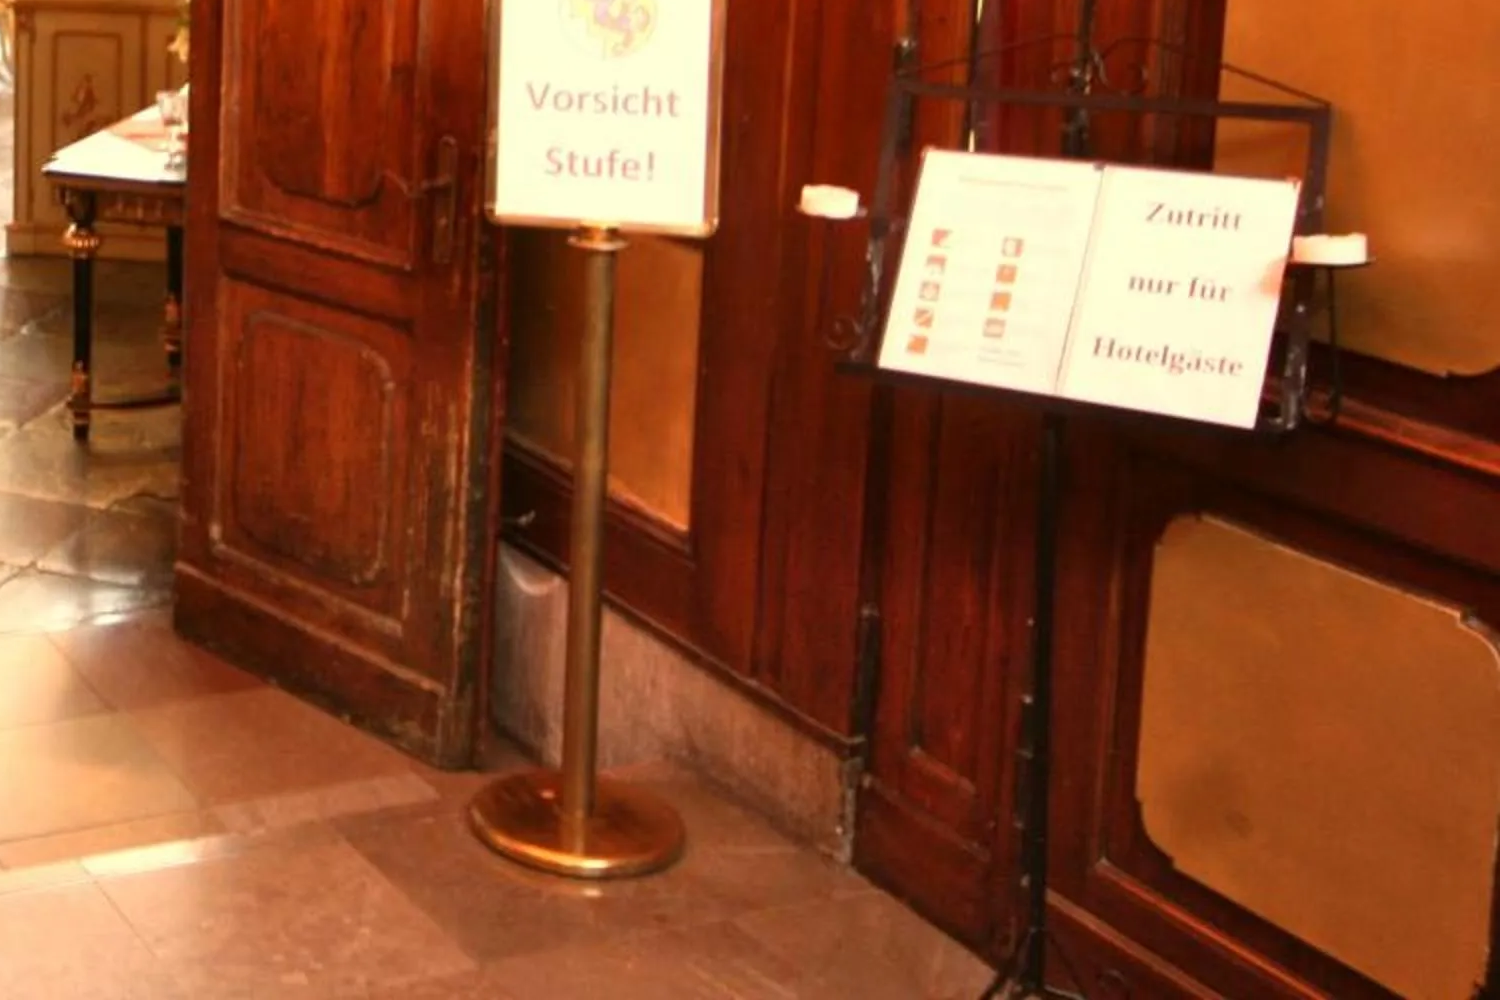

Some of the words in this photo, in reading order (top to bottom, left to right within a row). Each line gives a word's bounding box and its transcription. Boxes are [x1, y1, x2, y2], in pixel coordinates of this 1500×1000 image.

[525, 80, 681, 117] Vorsicht
[544, 147, 655, 181] Stufe!
[1145, 202, 1243, 231] Zutritt
[1128, 275, 1180, 295] nur
[1187, 276, 1233, 302] für
[1092, 336, 1244, 377] Hotelgäste
